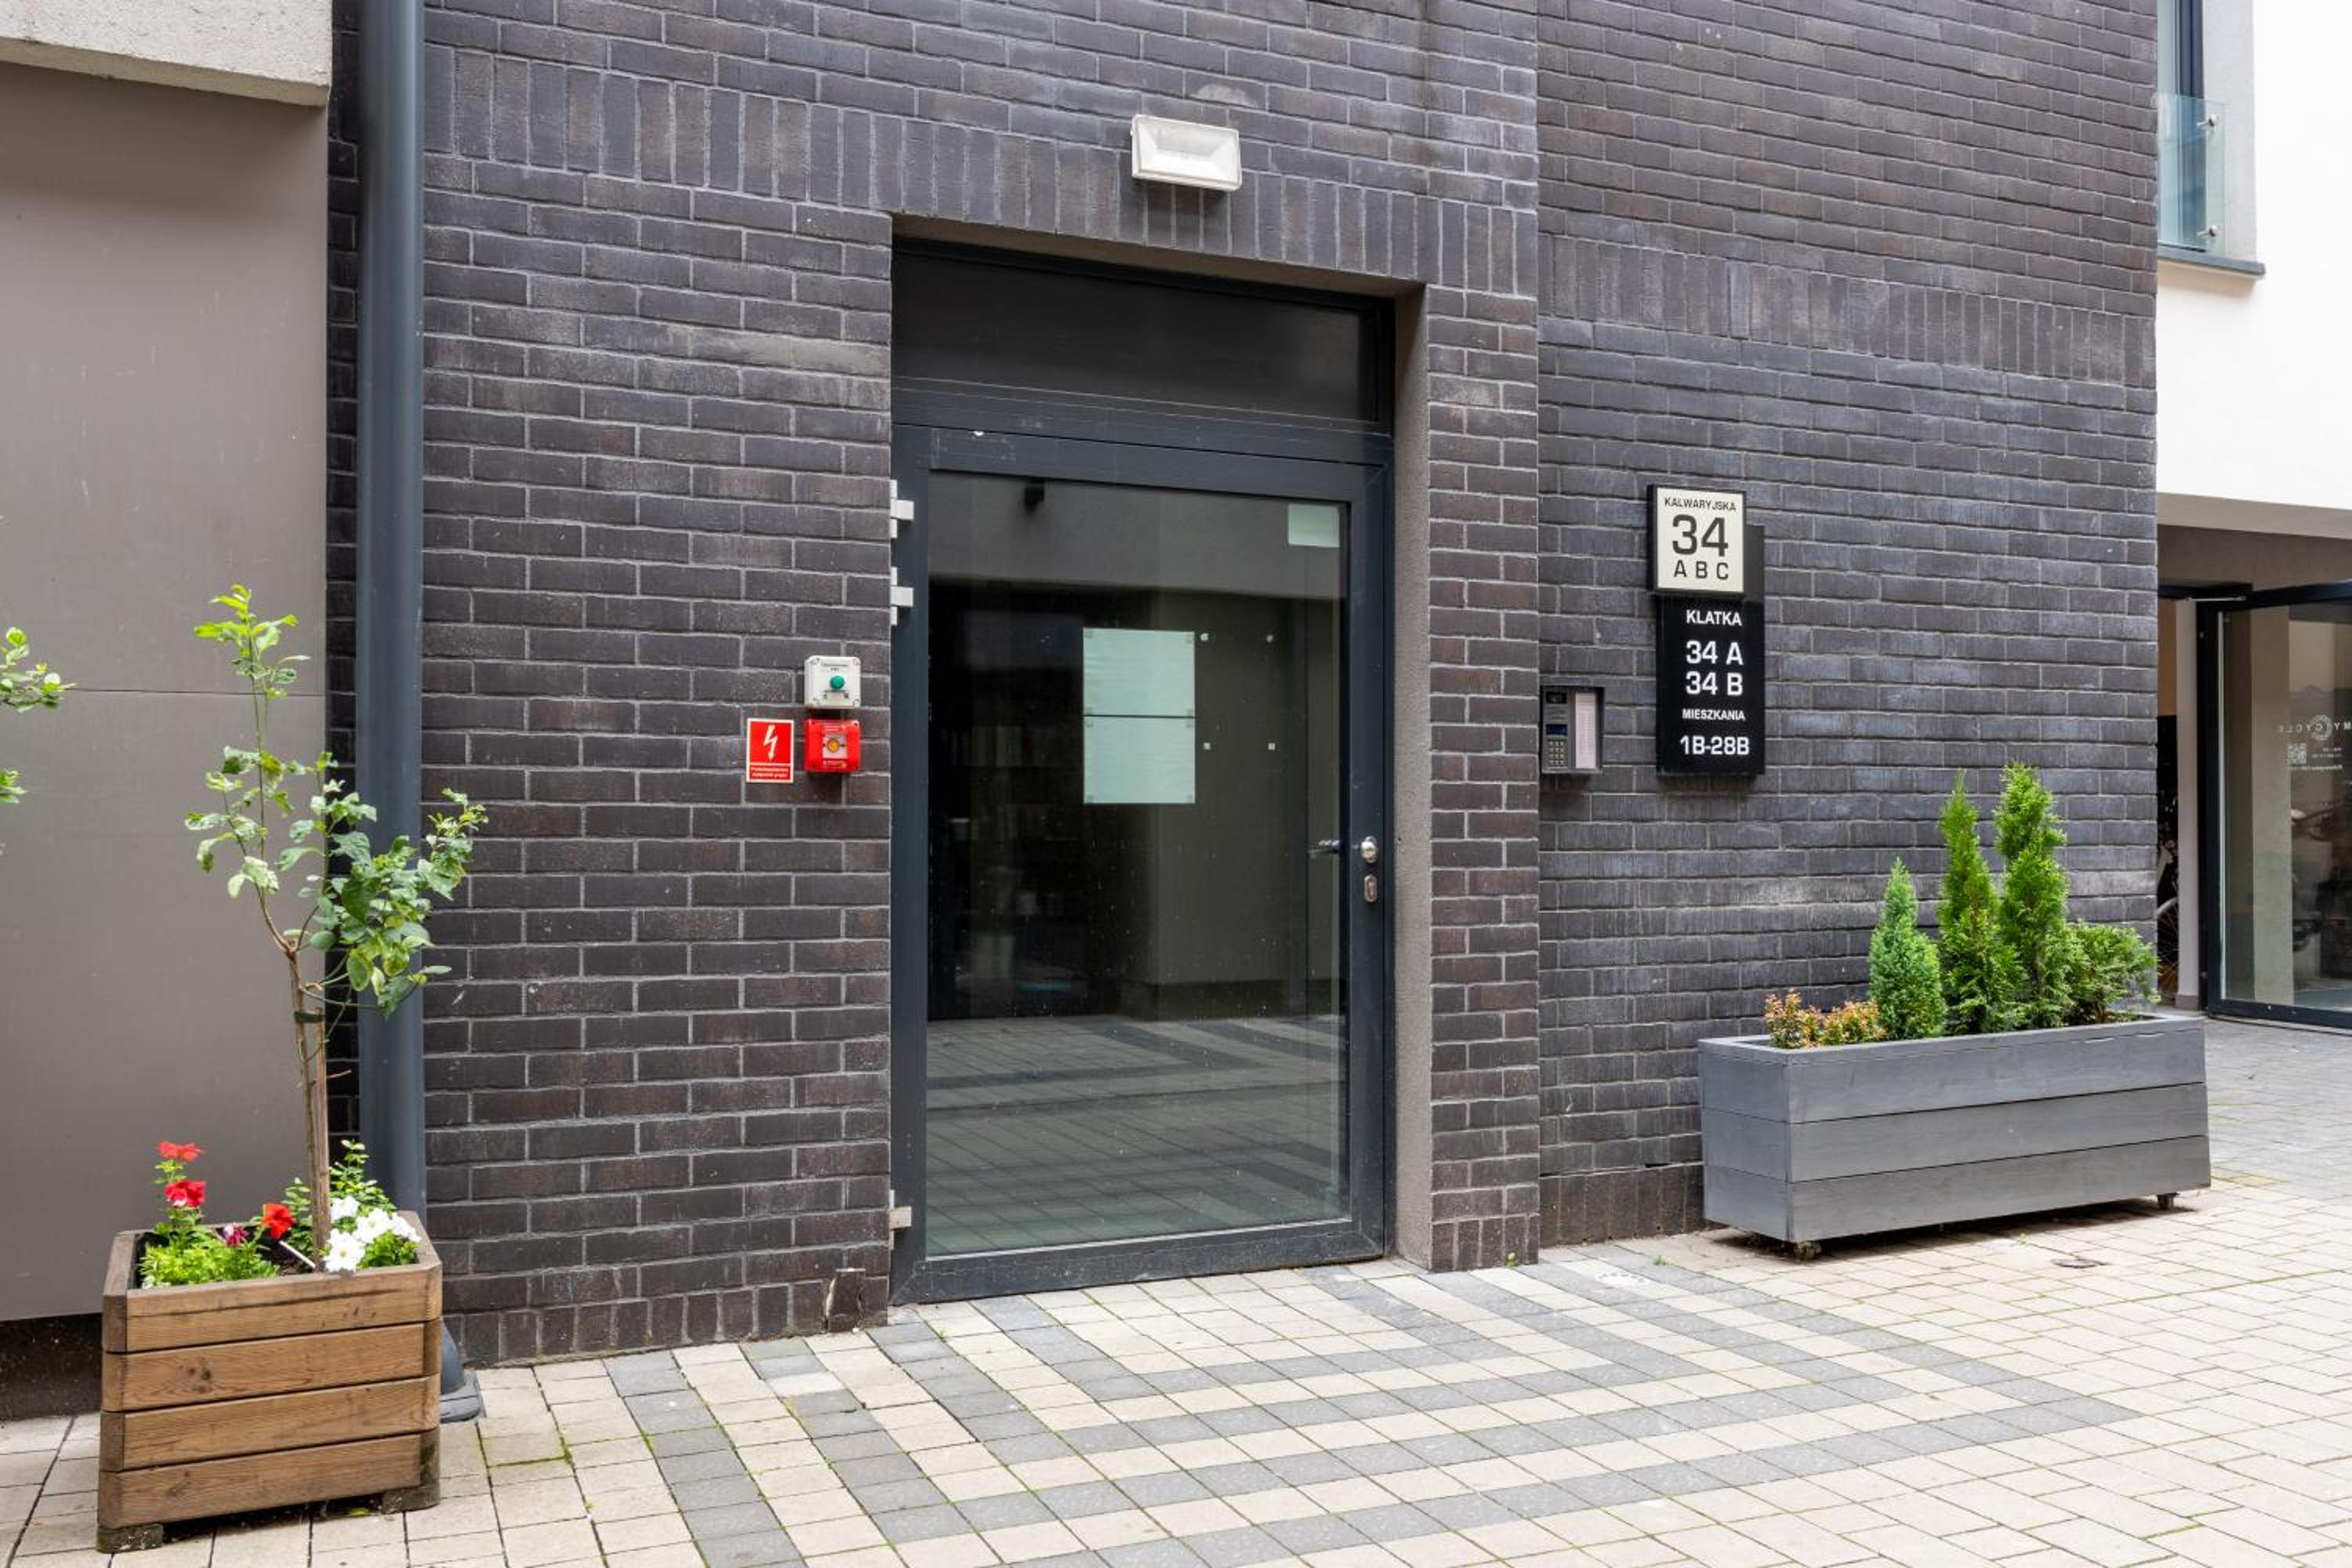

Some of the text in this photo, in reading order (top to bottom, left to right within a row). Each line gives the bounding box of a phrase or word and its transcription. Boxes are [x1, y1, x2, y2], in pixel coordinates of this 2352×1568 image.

[1664, 497, 1737, 511] KALWARYJSKA
[1672, 514, 1729, 557] 34
[1674, 559, 1729, 580] A B C
[1686, 609, 1743, 626] KLATKA
[1686, 640, 1744, 666] 34 A
[1686, 670, 1743, 696] 34 B
[1682, 708, 1746, 720] MIESZKANIA
[1680, 735, 1750, 755] 1B-28B
